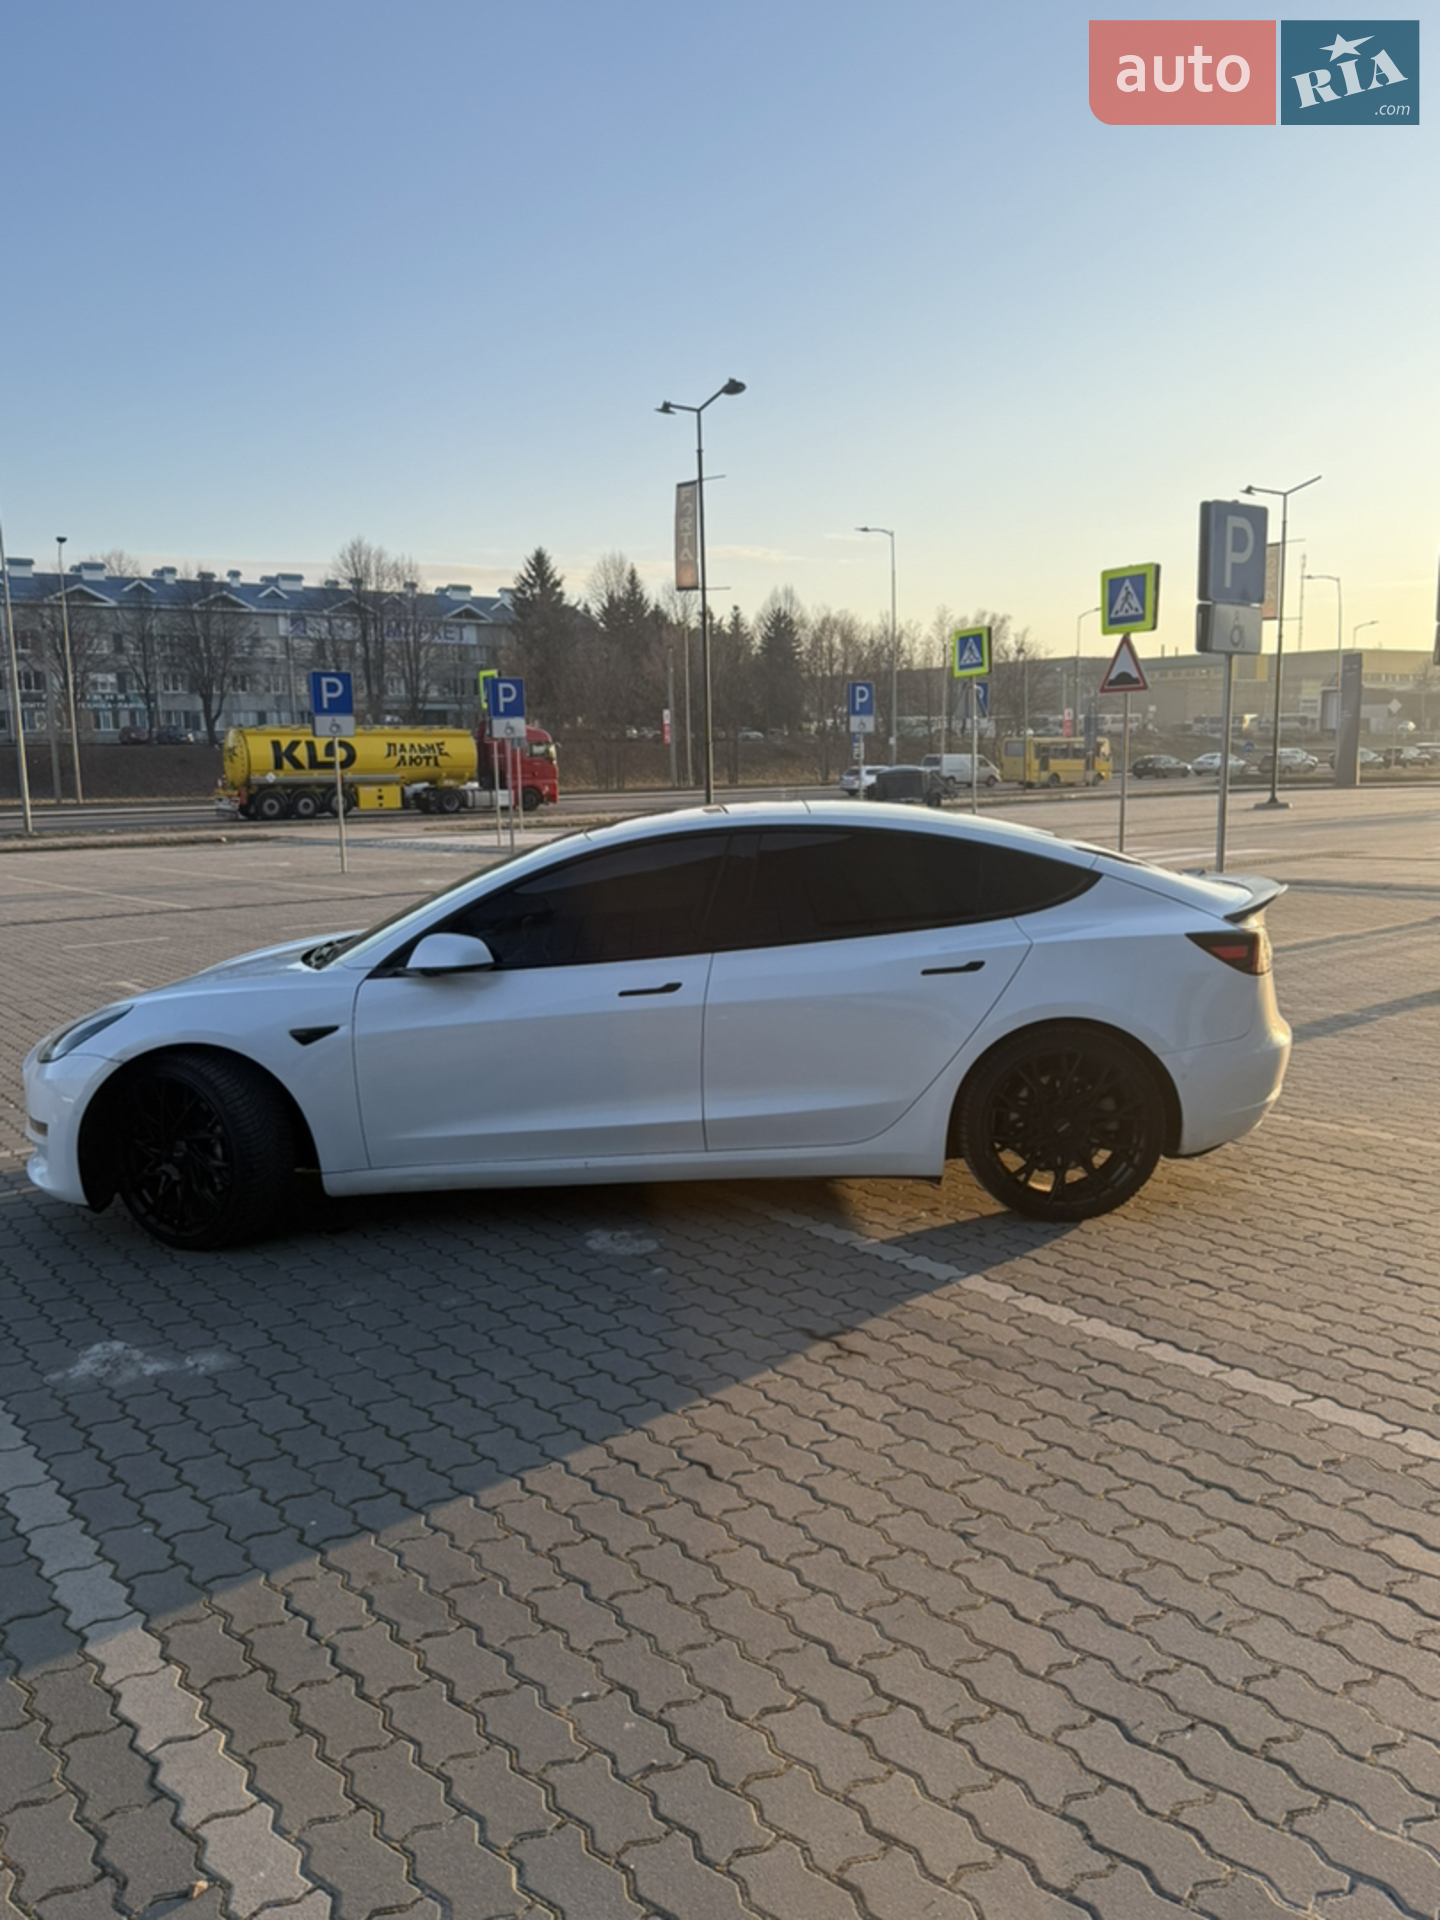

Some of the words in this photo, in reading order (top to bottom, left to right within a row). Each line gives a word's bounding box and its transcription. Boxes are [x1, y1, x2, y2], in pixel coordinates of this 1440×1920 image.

[1224, 515, 1255, 588] P
[321, 676, 344, 709] P
[497, 682, 517, 712] P
[855, 685, 870, 712] P
